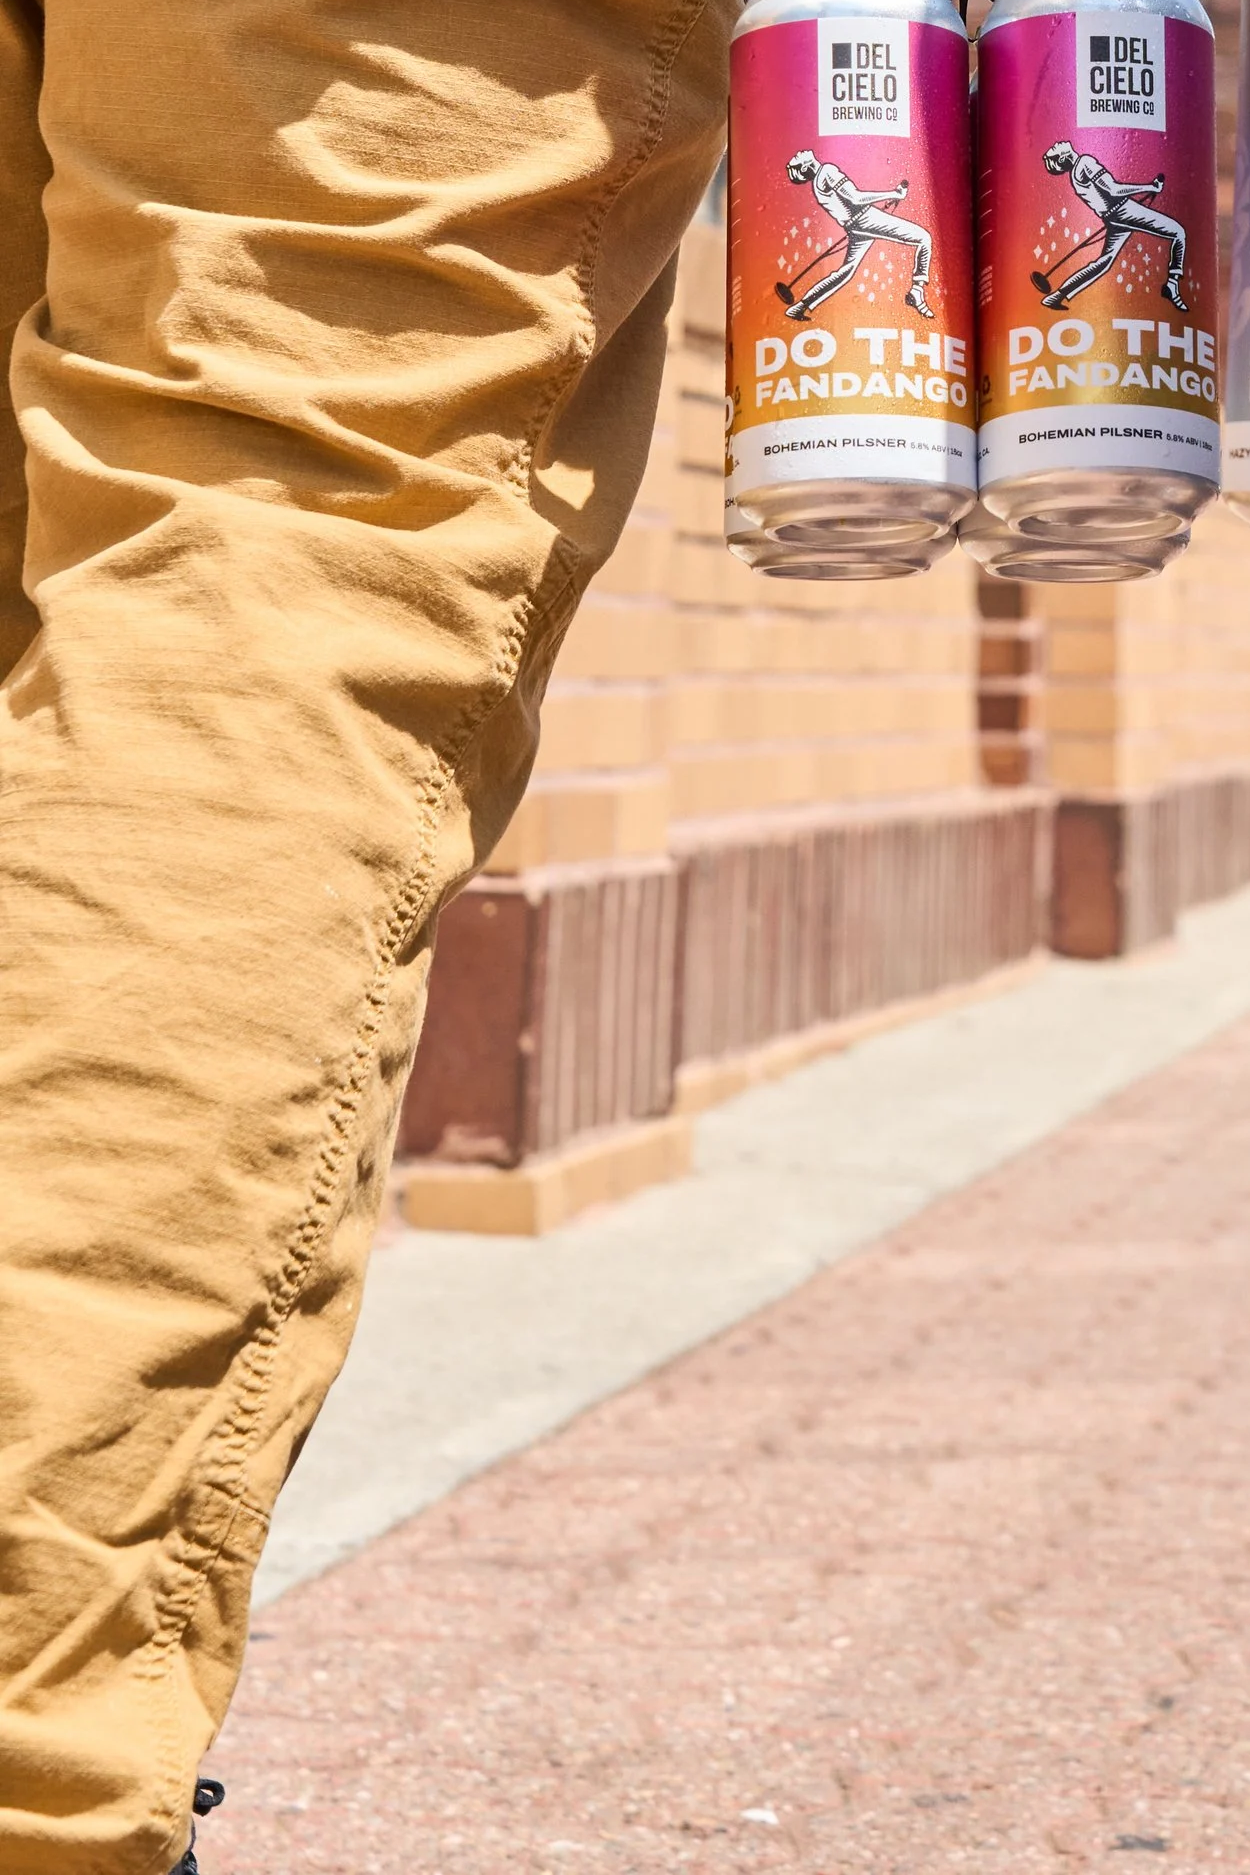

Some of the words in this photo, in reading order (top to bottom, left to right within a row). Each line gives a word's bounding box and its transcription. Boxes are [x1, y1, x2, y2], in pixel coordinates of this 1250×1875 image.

[856, 42, 896, 70] DEL
[1114, 36, 1154, 65] DEL
[832, 73, 897, 102] CIELO
[1090, 66, 1154, 97] CIELO
[832, 106, 883, 120] BREWING
[1090, 99, 1140, 114] BREWING
[755, 329, 837, 377] DO
[853, 327, 967, 377] THE
[1009, 319, 1095, 365] DO
[1112, 318, 1215, 372] THE
[755, 372, 967, 408] FANDANGO
[1009, 362, 1218, 402] FANDANGO
[764, 439, 837, 456] BOHEMIAN
[842, 438, 907, 448] PILSNER
[931, 444, 946, 453] ABV
[1018, 428, 1096, 444] BOHEMIAN
[1100, 427, 1163, 440] PILSNER
[1186, 437, 1198, 446] ABV
